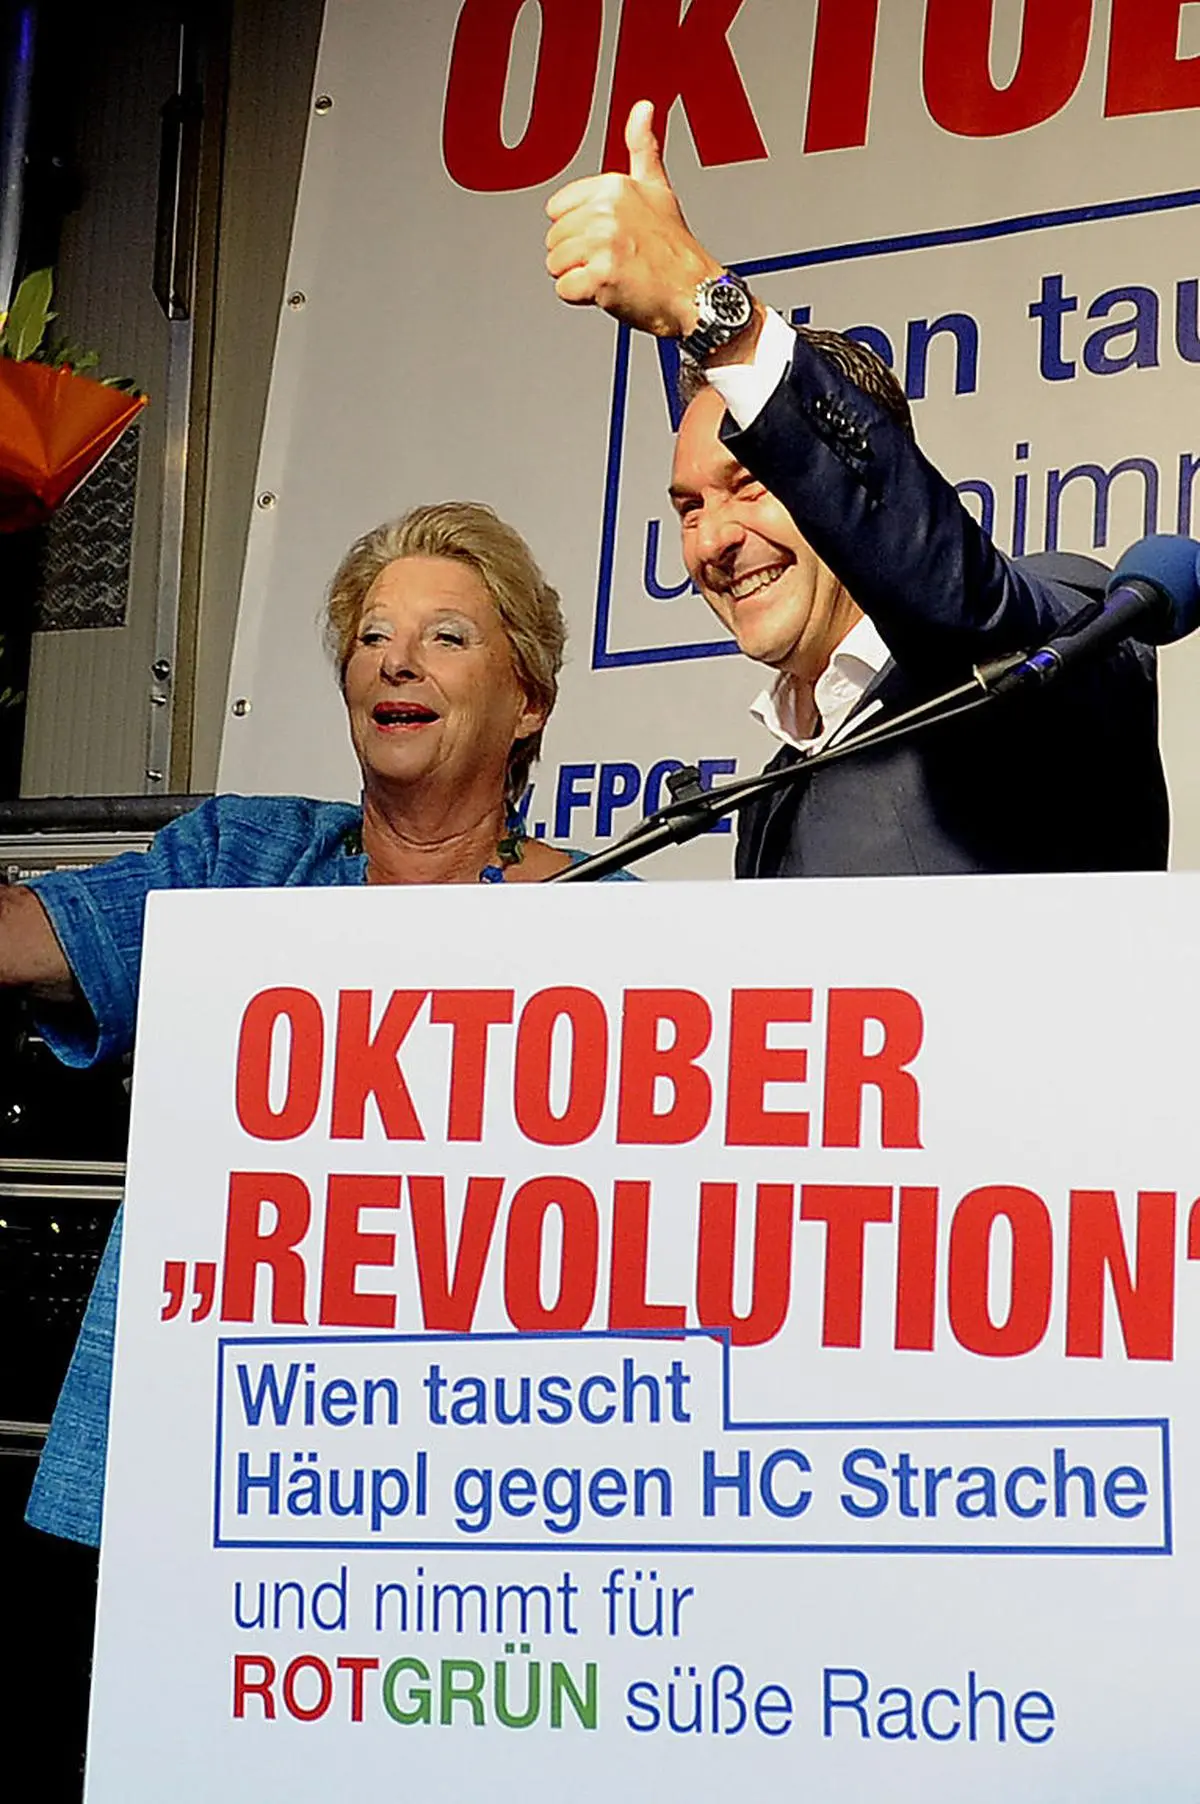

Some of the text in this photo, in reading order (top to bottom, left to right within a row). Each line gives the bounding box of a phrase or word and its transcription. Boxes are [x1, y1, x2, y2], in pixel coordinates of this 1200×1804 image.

[236, 985, 925, 1150] OKTOBER
[237, 1358, 691, 1427] Wien tauscht
[236, 1448, 1149, 1534] Häupl gegen HC Strache
[233, 1565, 696, 1637] und nimmt für
[232, 1643, 1056, 1745] ROTGRÜN süße Rache
